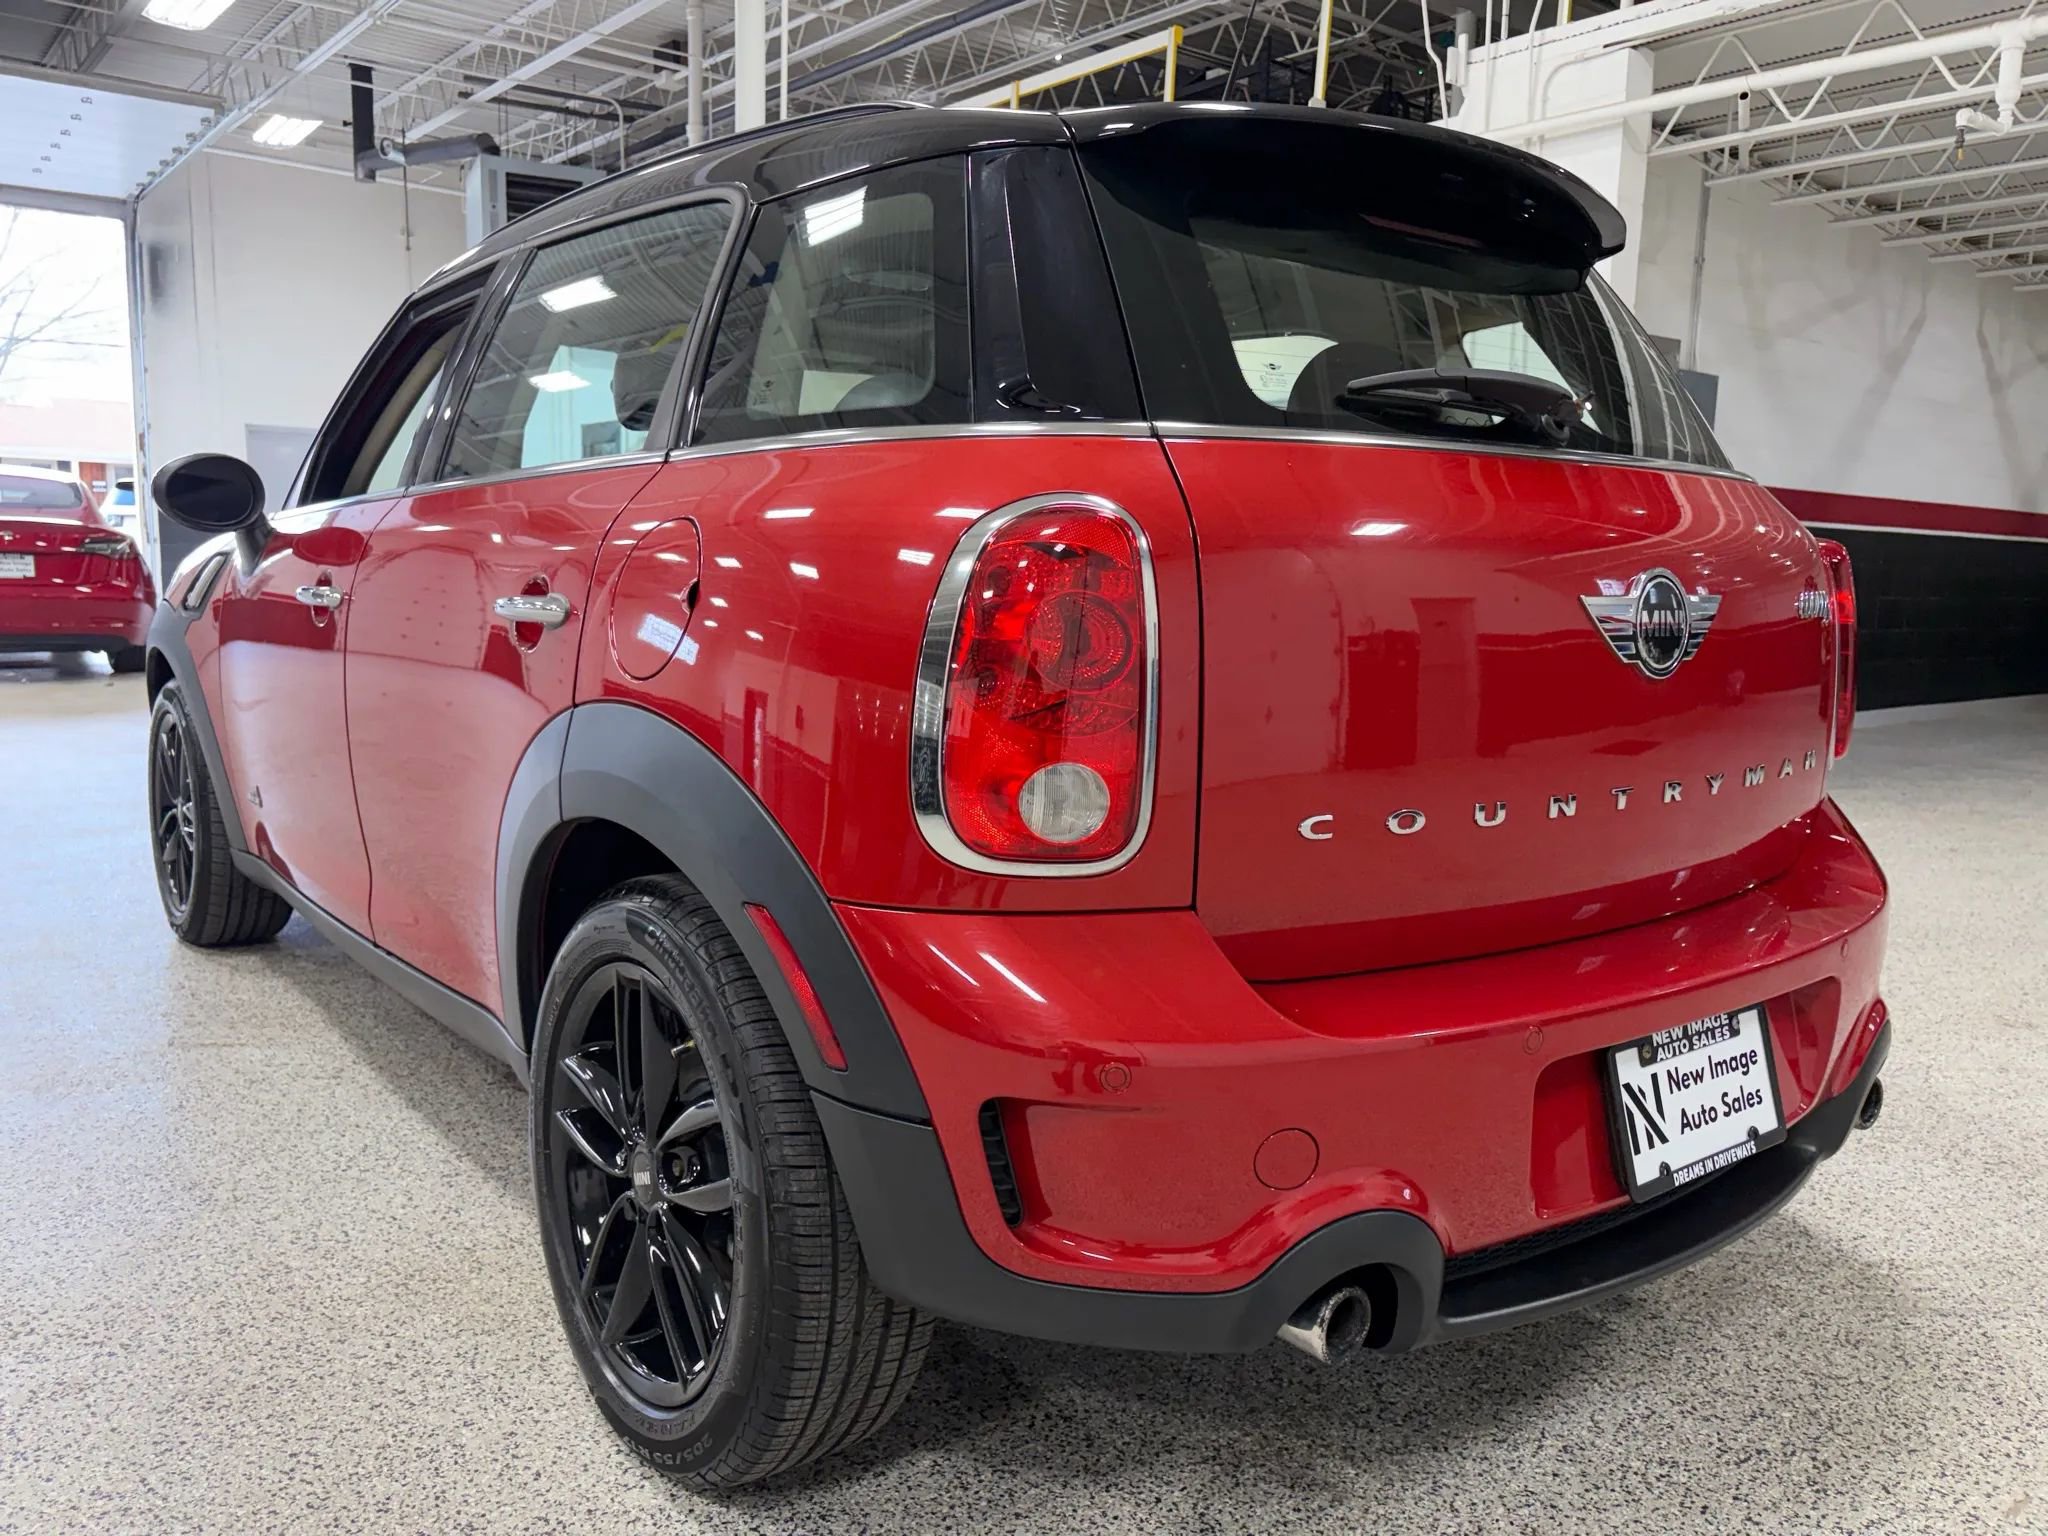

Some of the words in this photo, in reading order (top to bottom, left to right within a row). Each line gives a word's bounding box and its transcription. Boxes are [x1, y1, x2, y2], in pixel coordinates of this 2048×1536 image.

[1642, 610, 1684, 637] MINI
[1298, 750, 1817, 841] COUNTRYMAN
[1652, 1024, 1684, 1047] NEW
[1687, 1012, 1729, 1034] IMAGE
[1656, 1041, 1690, 1062] AUTO
[1692, 1025, 1731, 1050] SALES
[1666, 1065, 1705, 1095] New
[1708, 1048, 1759, 1080] Image
[1680, 1104, 1718, 1135] Auto
[1720, 1085, 1764, 1118] Sales
[634, 1171, 651, 1186] MINI
[1673, 1161, 1706, 1187] DREAMS
[1713, 1140, 1757, 1169] DRIVEWAYS
